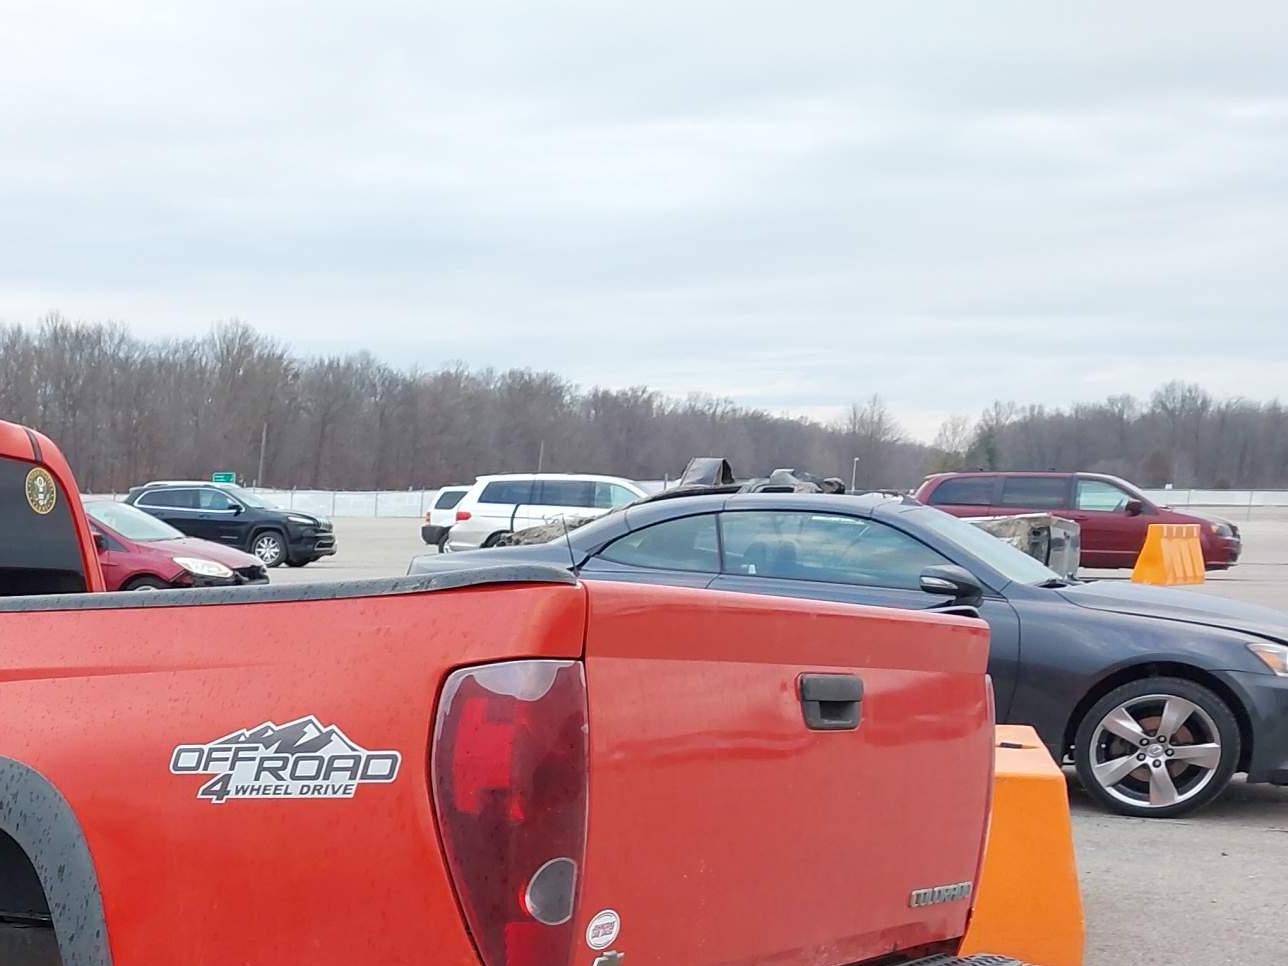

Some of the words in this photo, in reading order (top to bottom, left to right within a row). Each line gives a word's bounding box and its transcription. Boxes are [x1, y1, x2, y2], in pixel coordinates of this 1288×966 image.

[200, 773, 232, 801] 4
[234, 784, 293, 796] WHEEL
[298, 783, 355, 796] DRIVE
